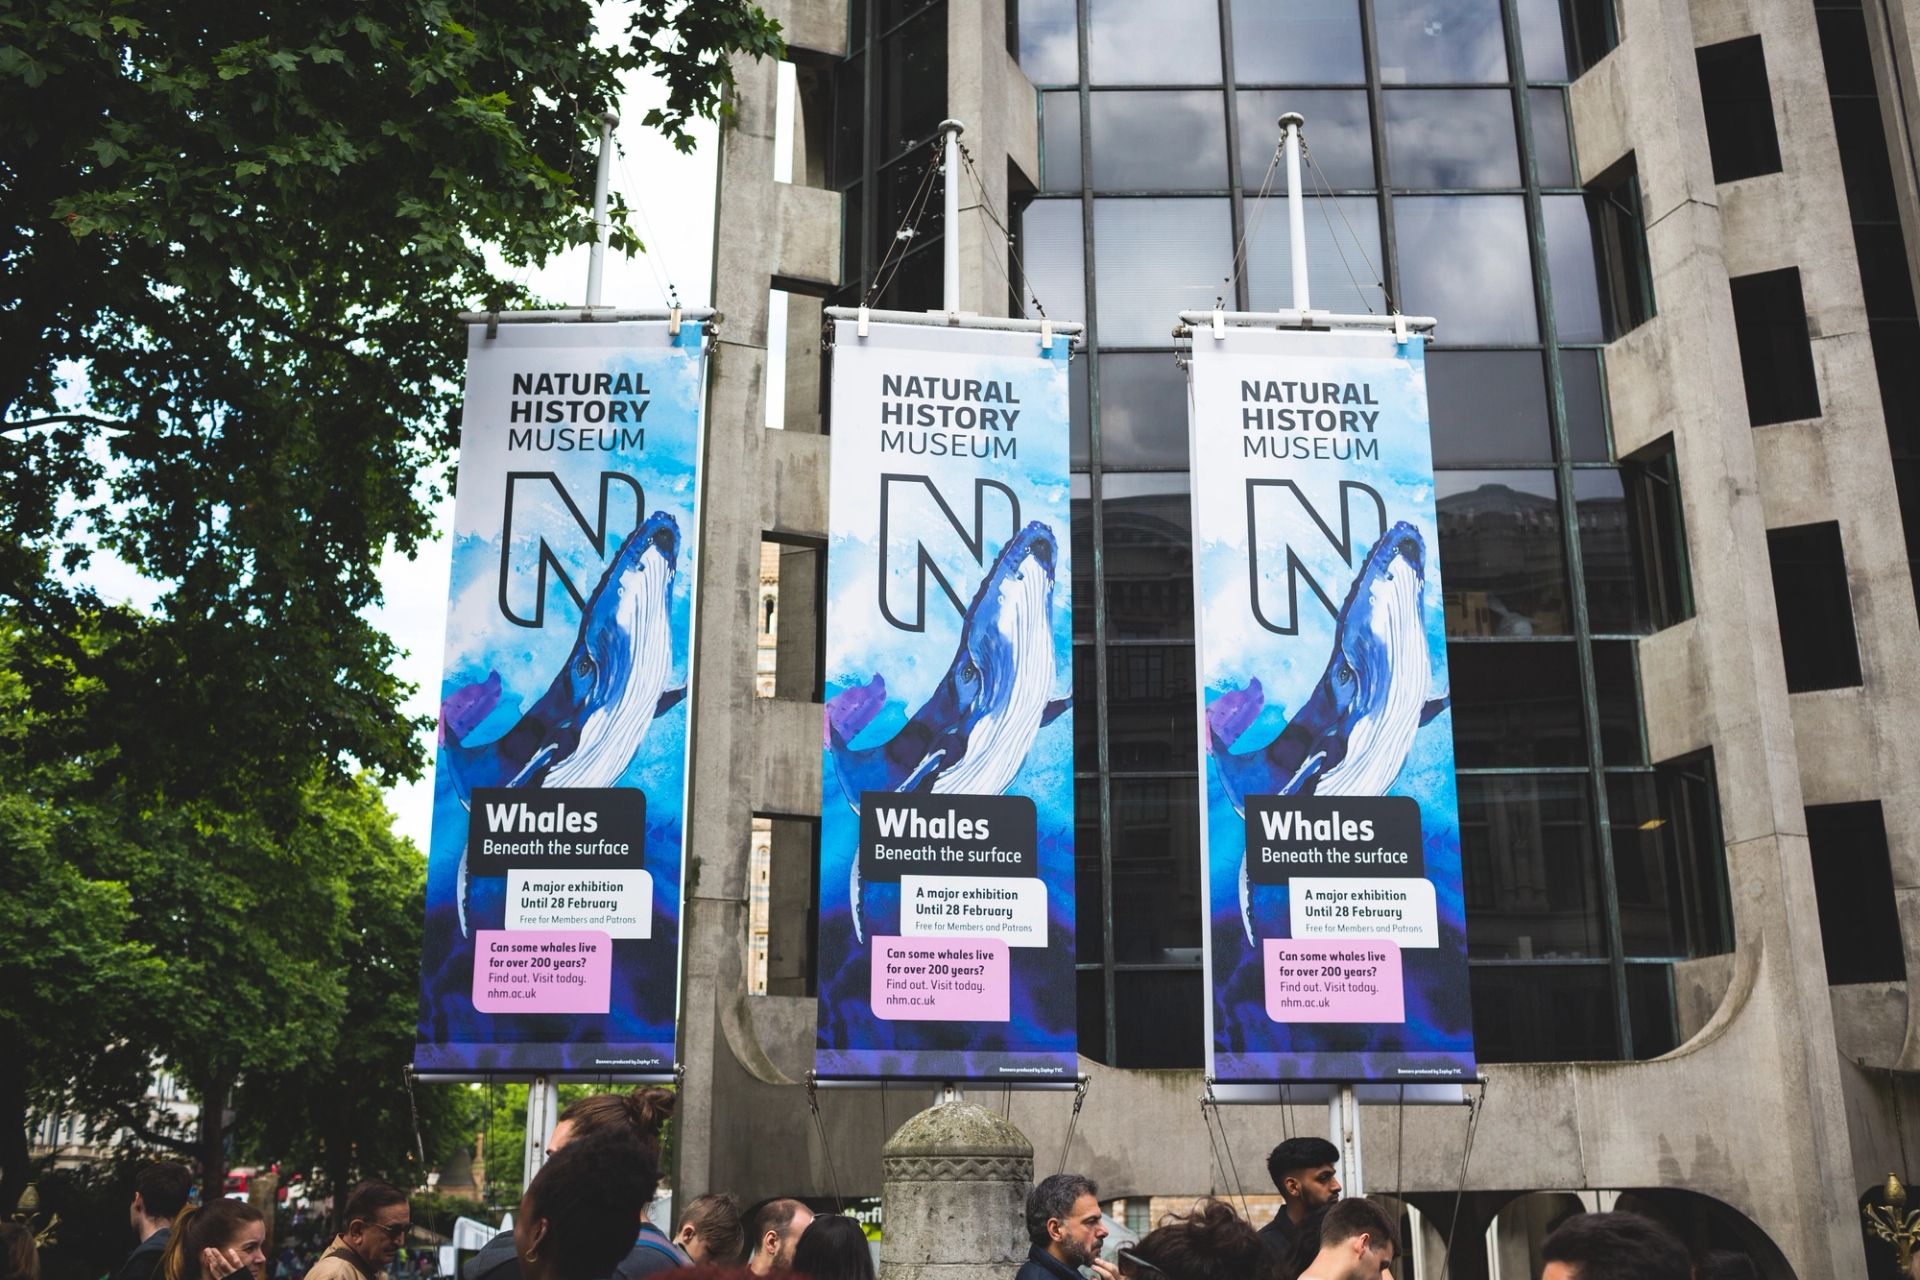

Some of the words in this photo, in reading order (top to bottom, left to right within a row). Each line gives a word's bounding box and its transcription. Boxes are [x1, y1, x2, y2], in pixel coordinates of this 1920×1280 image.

[512, 373, 650, 395] NATURAL
[882, 374, 1020, 404] NATURAL
[1241, 380, 1379, 405] NATURAL
[510, 400, 650, 423] HISTORY
[881, 402, 1020, 431] HISTORY
[1242, 408, 1380, 432] HISTORY
[508, 428, 644, 451] MUSEUM
[881, 430, 1017, 460] MUSEUM
[1243, 435, 1379, 461] MUSEUM
[485, 803, 598, 833] Whales
[875, 808, 990, 840] Whales
[1260, 810, 1374, 841] Whales
[483, 839, 544, 855] Beneath
[548, 840, 572, 855] the
[575, 839, 629, 855] surface
[875, 844, 936, 861] Beneath
[940, 846, 964, 862] the
[968, 847, 1022, 863] surface
[1262, 848, 1323, 863] Beneath
[1326, 848, 1351, 863] the
[1354, 848, 1408, 864] surface
[522, 881, 530, 892] A
[533, 882, 565, 894] major
[568, 881, 624, 892] exhibition
[916, 888, 924, 898] A
[927, 889, 960, 902] major
[962, 889, 1018, 900] exhibition
[1305, 890, 1313, 900] A
[1315, 890, 1348, 903] major
[1350, 890, 1407, 901] exhibition
[521, 898, 548, 908] Until
[551, 898, 564, 908] 28
[568, 898, 618, 911] February
[916, 904, 943, 915] Until
[946, 905, 960, 916] 28
[963, 905, 1013, 919] February
[520, 915, 537, 924] Free
[538, 915, 550, 924] for
[551, 915, 588, 924] Members
[589, 915, 604, 924] and
[606, 915, 636, 924] Patrons
[1305, 906, 1332, 917] Until
[1335, 906, 1349, 917] 28
[1352, 906, 1402, 920] February
[916, 922, 932, 931] Free
[934, 922, 945, 931] for
[947, 922, 984, 932] Members
[986, 923, 1001, 932] and
[1002, 924, 1033, 932] Patrons
[1306, 923, 1323, 932] Free
[1324, 923, 1336, 933] for
[1337, 924, 1374, 933] Members
[1376, 924, 1390, 933] and
[1392, 924, 1423, 933] Patrons
[490, 942, 509, 953] Can
[511, 945, 538, 953] some
[540, 942, 577, 953] whales
[578, 942, 597, 953] live
[887, 949, 906, 959] Can
[908, 951, 935, 959] some
[937, 950, 974, 960] whales
[975, 950, 994, 960] live
[1279, 951, 1298, 961] Can
[1300, 954, 1328, 962] some
[1329, 952, 1366, 962] whales
[1367, 952, 1386, 962] live
[489, 958, 504, 968] for
[530, 958, 551, 968] 200
[553, 958, 586, 970] years?
[886, 964, 902, 974] for
[928, 965, 949, 975] 200
[951, 965, 984, 977] years?
[488, 973, 509, 983] Find
[511, 974, 530, 983] out.
[532, 973, 553, 983] Visit
[556, 973, 587, 986] today.
[1280, 966, 1294, 977] for
[1321, 967, 1342, 977] 200
[1344, 967, 1377, 979] years?
[886, 979, 907, 990] Find
[909, 980, 928, 990] out.
[930, 980, 952, 990] Visit
[954, 980, 985, 993] today.
[1280, 982, 1301, 992] Find
[1303, 983, 1322, 992] out.
[1324, 982, 1346, 992] Visit
[1348, 982, 1379, 995] today.
[487, 989, 536, 998] nhm.ac.uk
[886, 995, 936, 1006] nhm.ac.uk
[1281, 997, 1330, 1008] nhm.ac.uk
